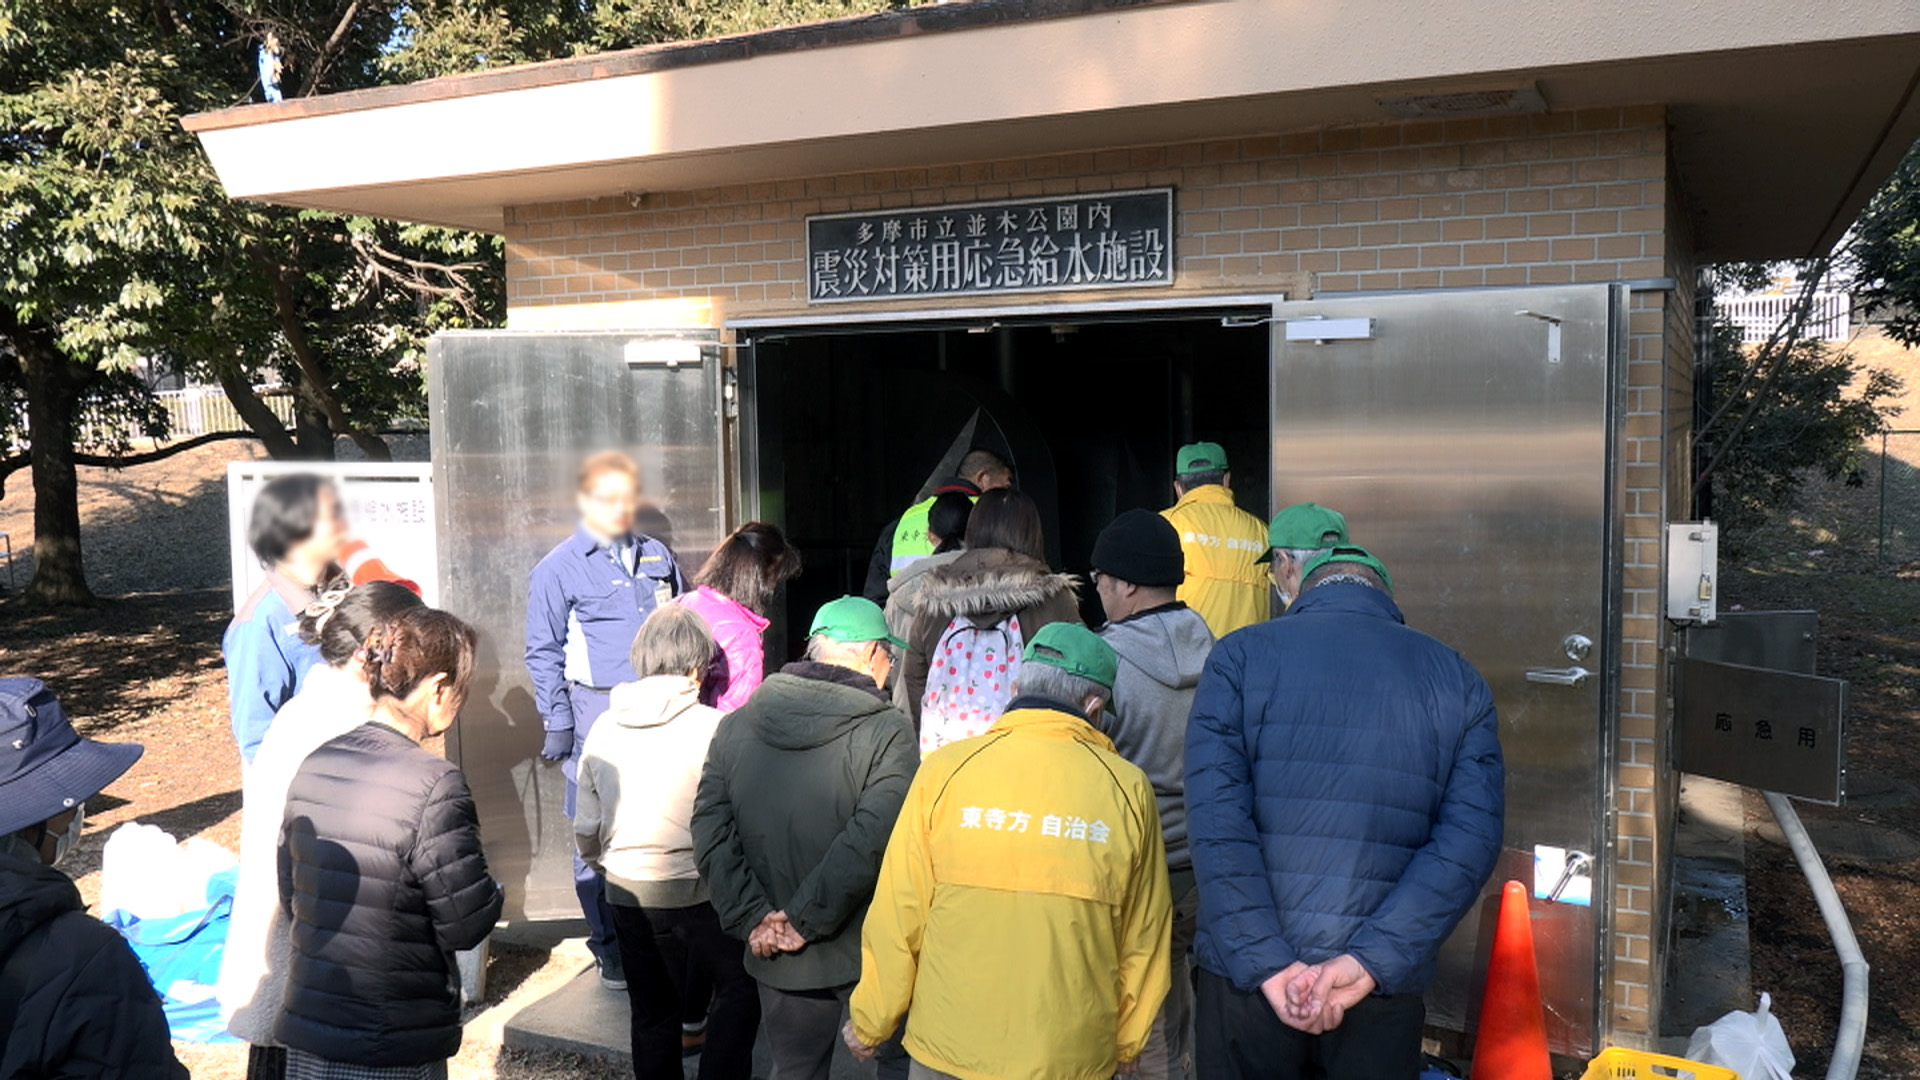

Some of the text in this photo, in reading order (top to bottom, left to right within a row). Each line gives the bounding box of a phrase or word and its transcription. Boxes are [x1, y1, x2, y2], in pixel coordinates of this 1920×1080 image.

[857, 203, 1112, 245] 多摩市立並木公園内
[813, 228, 1165, 297] 震災対策用応急給水施設
[960, 806, 1111, 843] 東寺方 自治会
